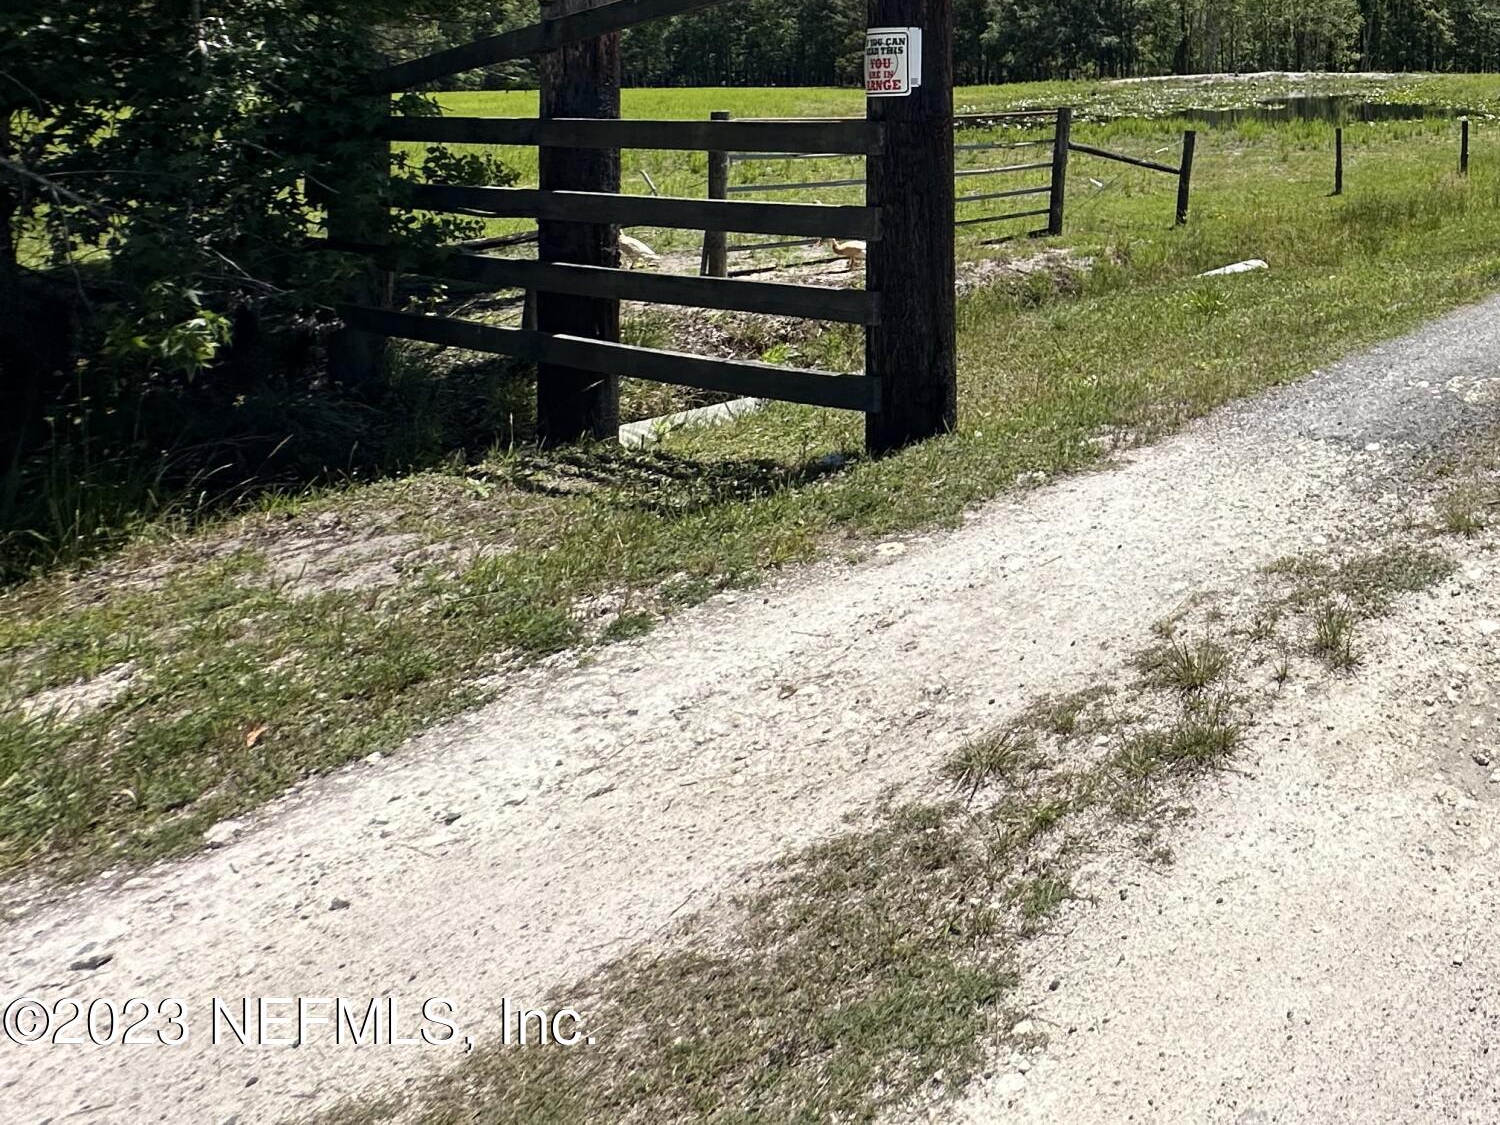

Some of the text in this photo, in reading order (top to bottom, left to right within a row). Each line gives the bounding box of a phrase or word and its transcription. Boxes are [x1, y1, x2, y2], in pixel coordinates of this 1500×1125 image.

[885, 37, 906, 46] CAN
[881, 46, 903, 55] THIS
[870, 58, 892, 69] YOU
[868, 70, 894, 79] ARE IN
